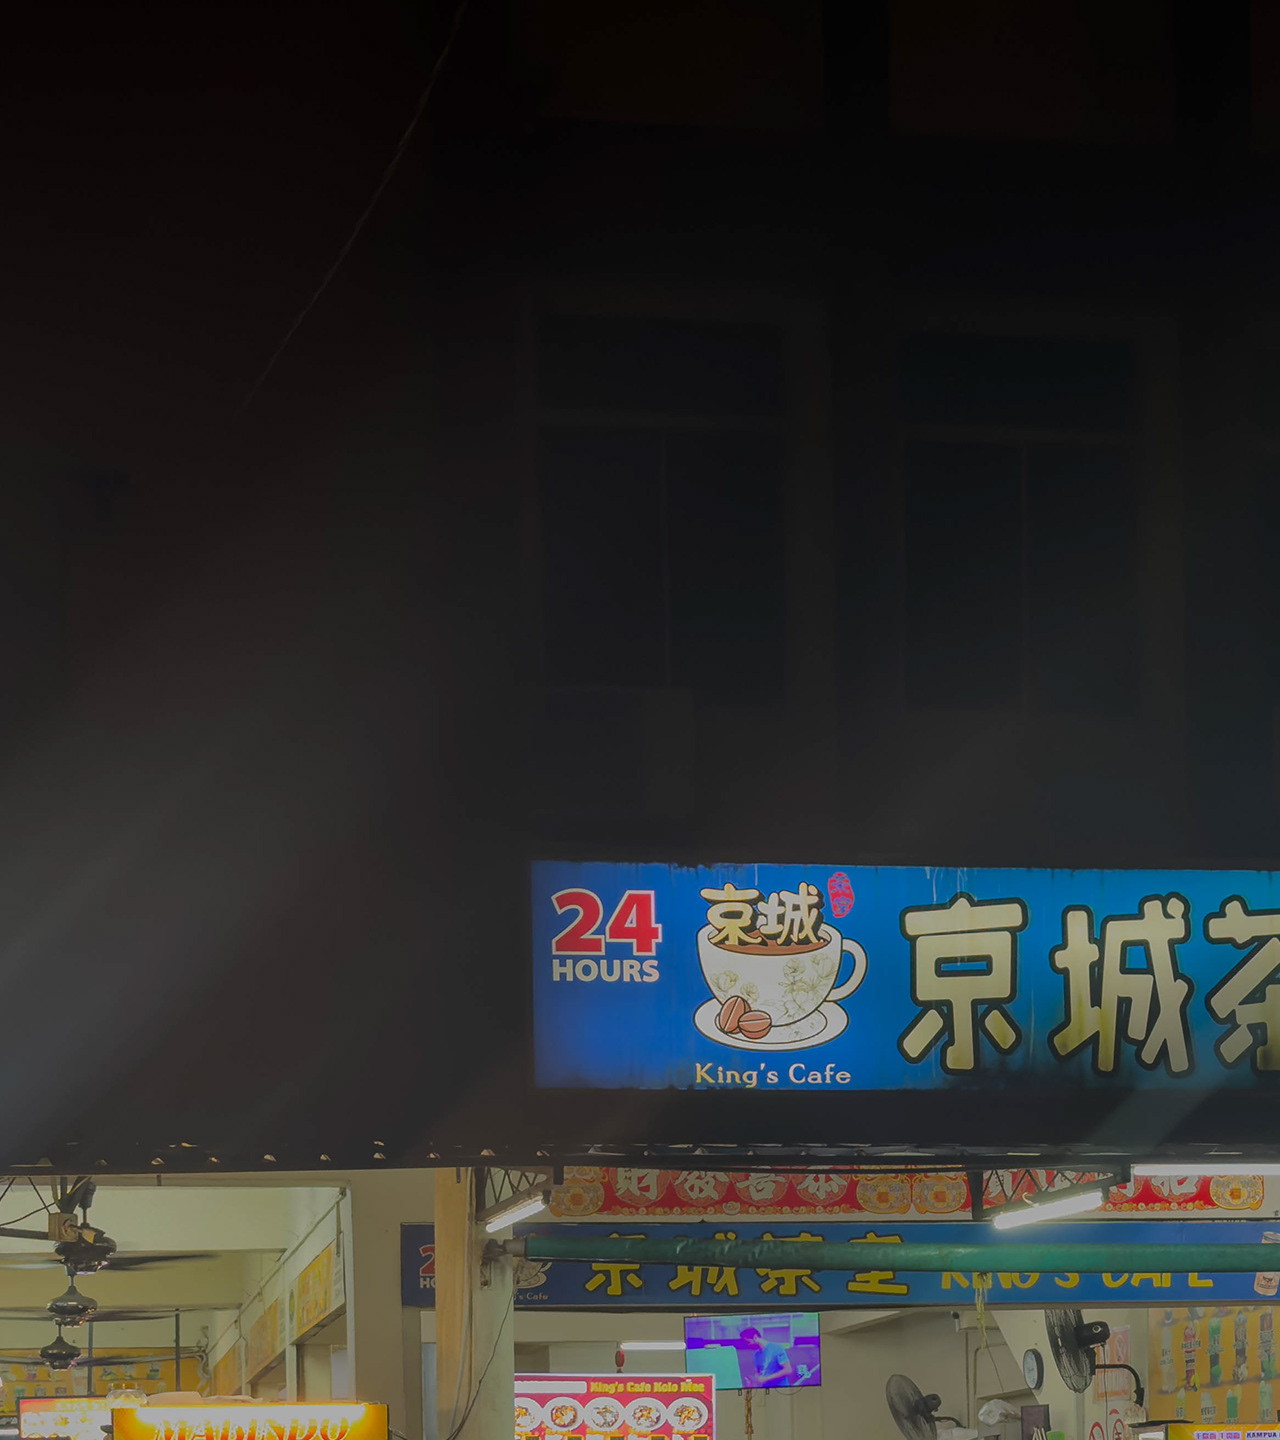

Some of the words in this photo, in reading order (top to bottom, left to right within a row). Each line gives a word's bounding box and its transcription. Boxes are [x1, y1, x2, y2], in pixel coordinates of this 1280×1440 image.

[550, 888, 663, 956] 24
[699, 881, 828, 946] 京城
[551, 960, 660, 983] HOURS
[695, 1063, 778, 1088] King's
[787, 1063, 852, 1086] Cafe
